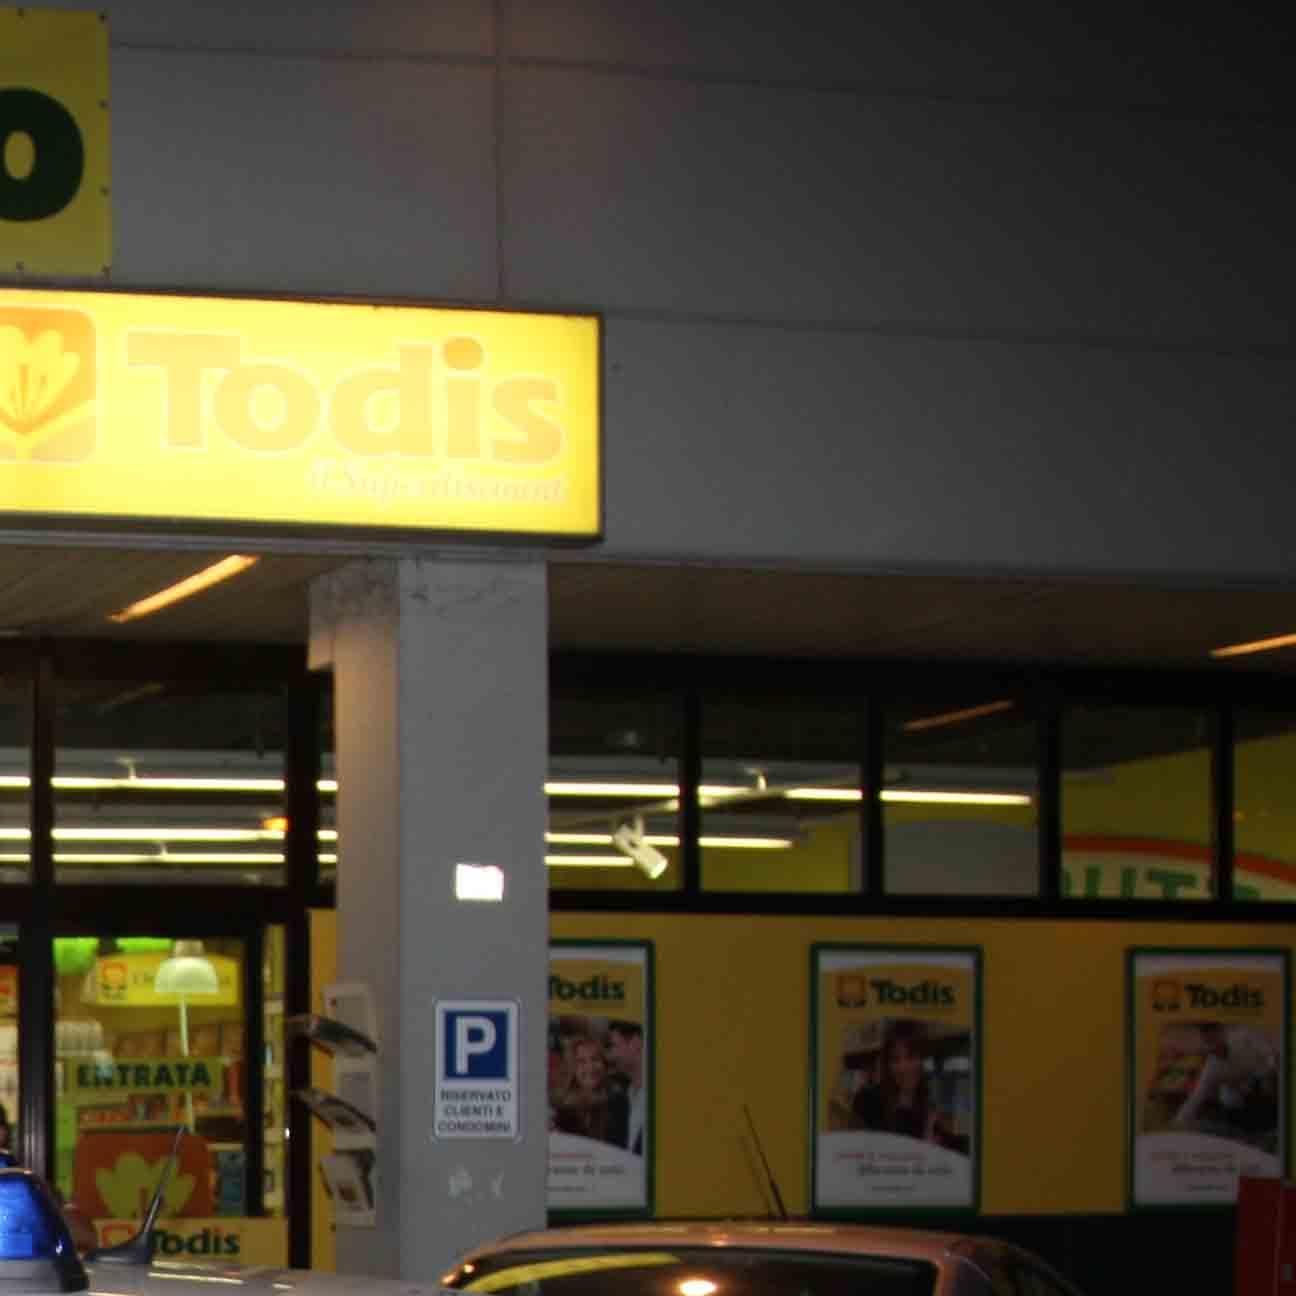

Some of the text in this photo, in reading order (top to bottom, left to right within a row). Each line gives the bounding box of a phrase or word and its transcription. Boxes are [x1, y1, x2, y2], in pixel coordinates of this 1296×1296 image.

[125, 334, 568, 466] Todis
[870, 978, 956, 1006] Todis
[1184, 982, 1263, 1009] Todis
[455, 1015, 497, 1074] P
[78, 1059, 212, 1087] ENTRATA
[152, 1225, 241, 1255] Todis
